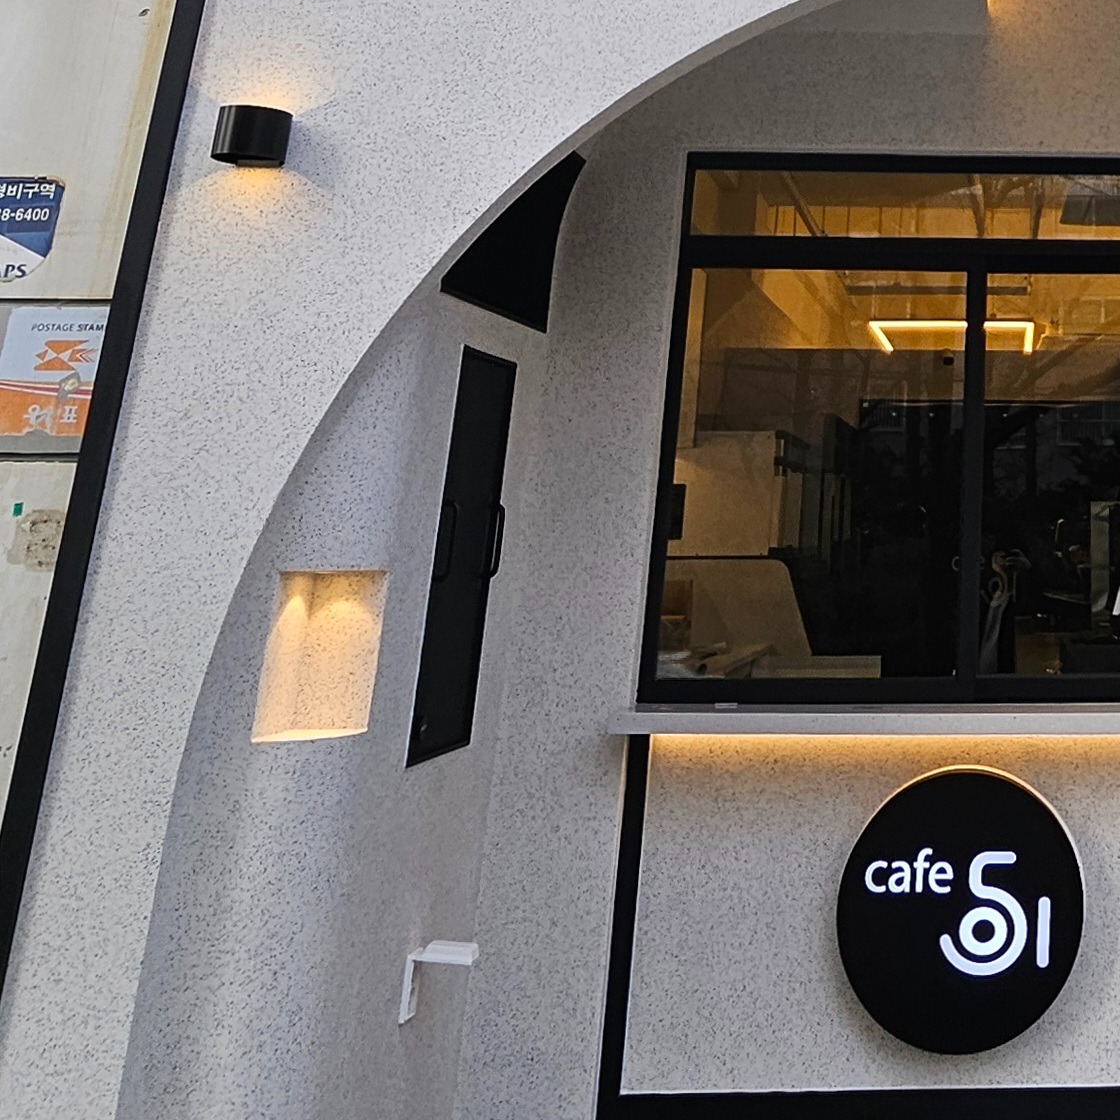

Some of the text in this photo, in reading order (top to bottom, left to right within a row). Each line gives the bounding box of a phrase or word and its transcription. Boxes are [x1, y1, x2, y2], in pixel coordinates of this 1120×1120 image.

[0, 207, 50, 221] 8-6400
[0, 263, 27, 279] PS
[31, 323, 74, 332] POSTAGE
[864, 847, 954, 894] cafe
